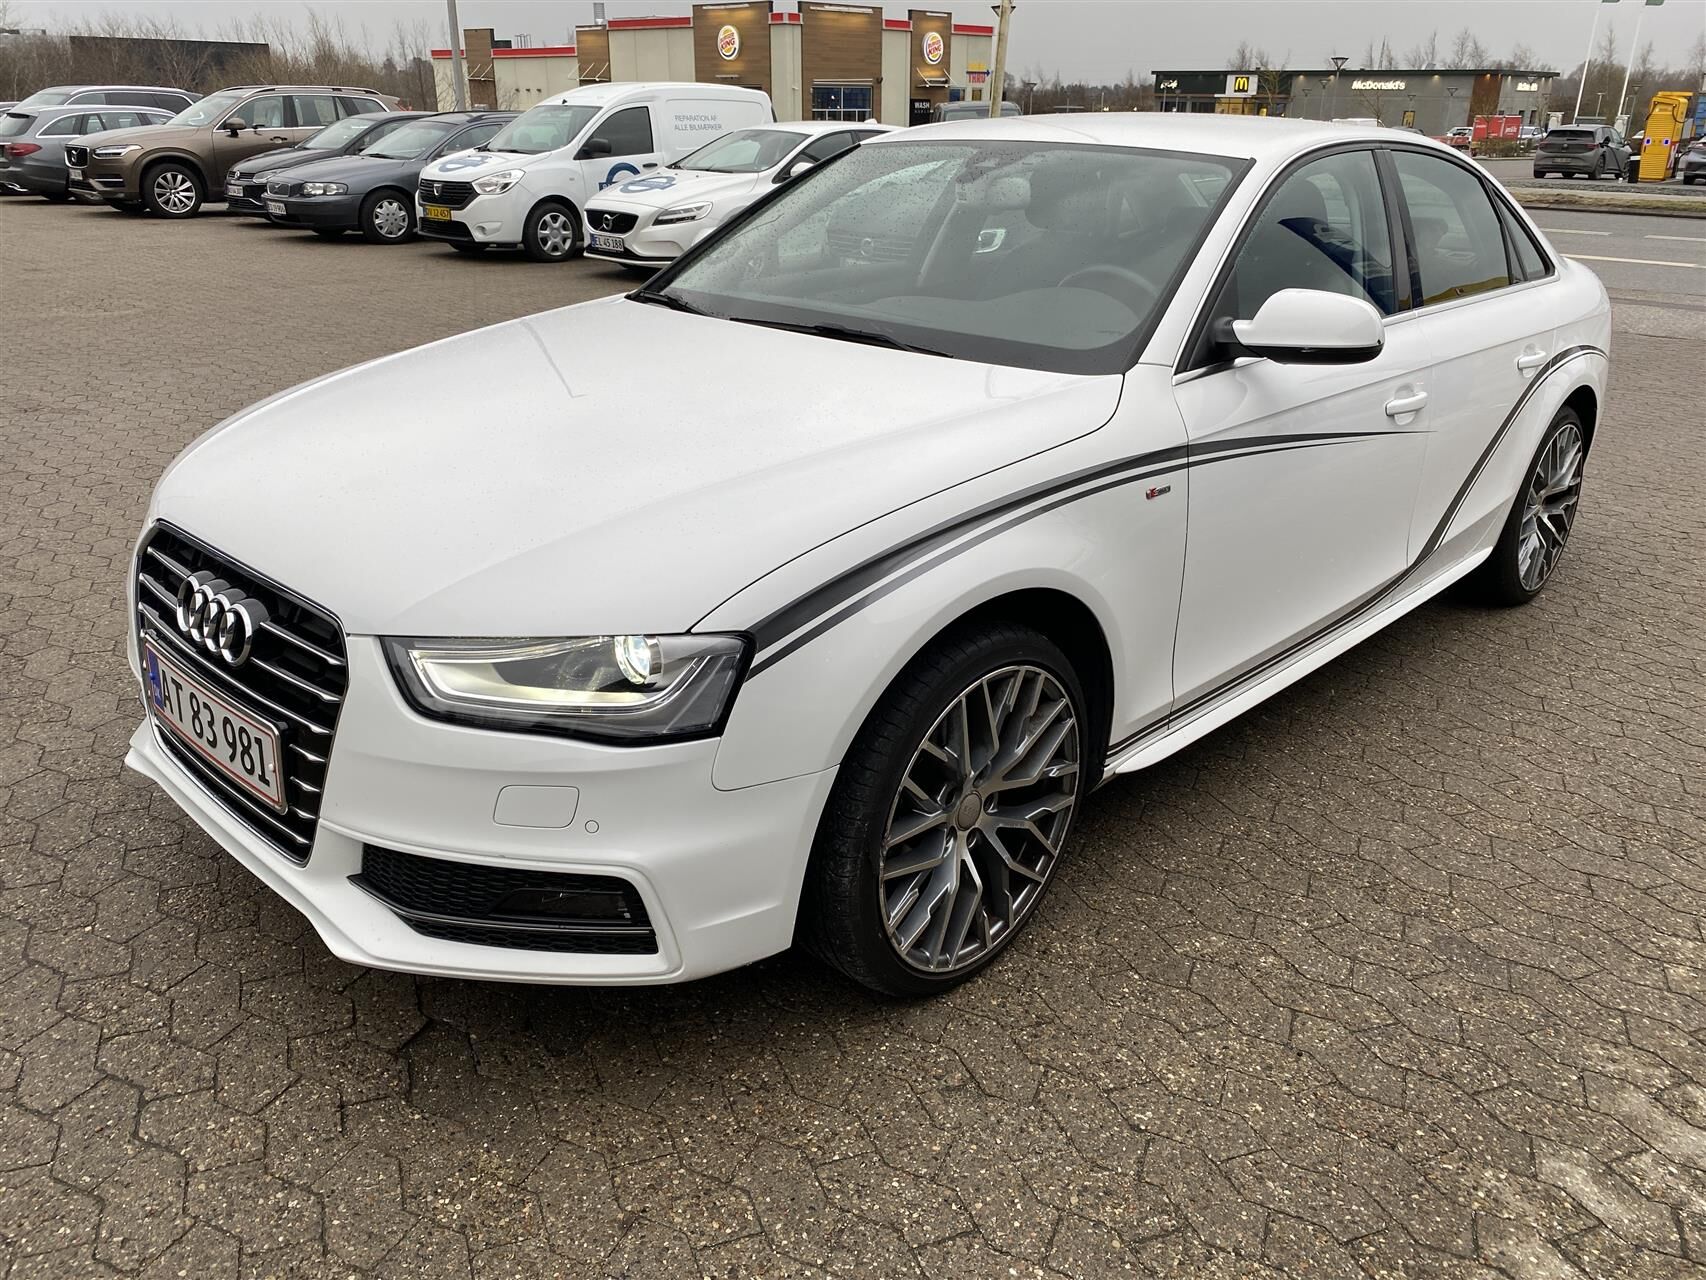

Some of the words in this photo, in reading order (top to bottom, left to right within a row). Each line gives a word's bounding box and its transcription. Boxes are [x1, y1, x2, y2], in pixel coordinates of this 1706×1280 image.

[1351, 80, 1406, 90] McDonald's
[161, 669, 183, 723] AT
[189, 690, 218, 749] 83
[222, 716, 271, 788] 981
